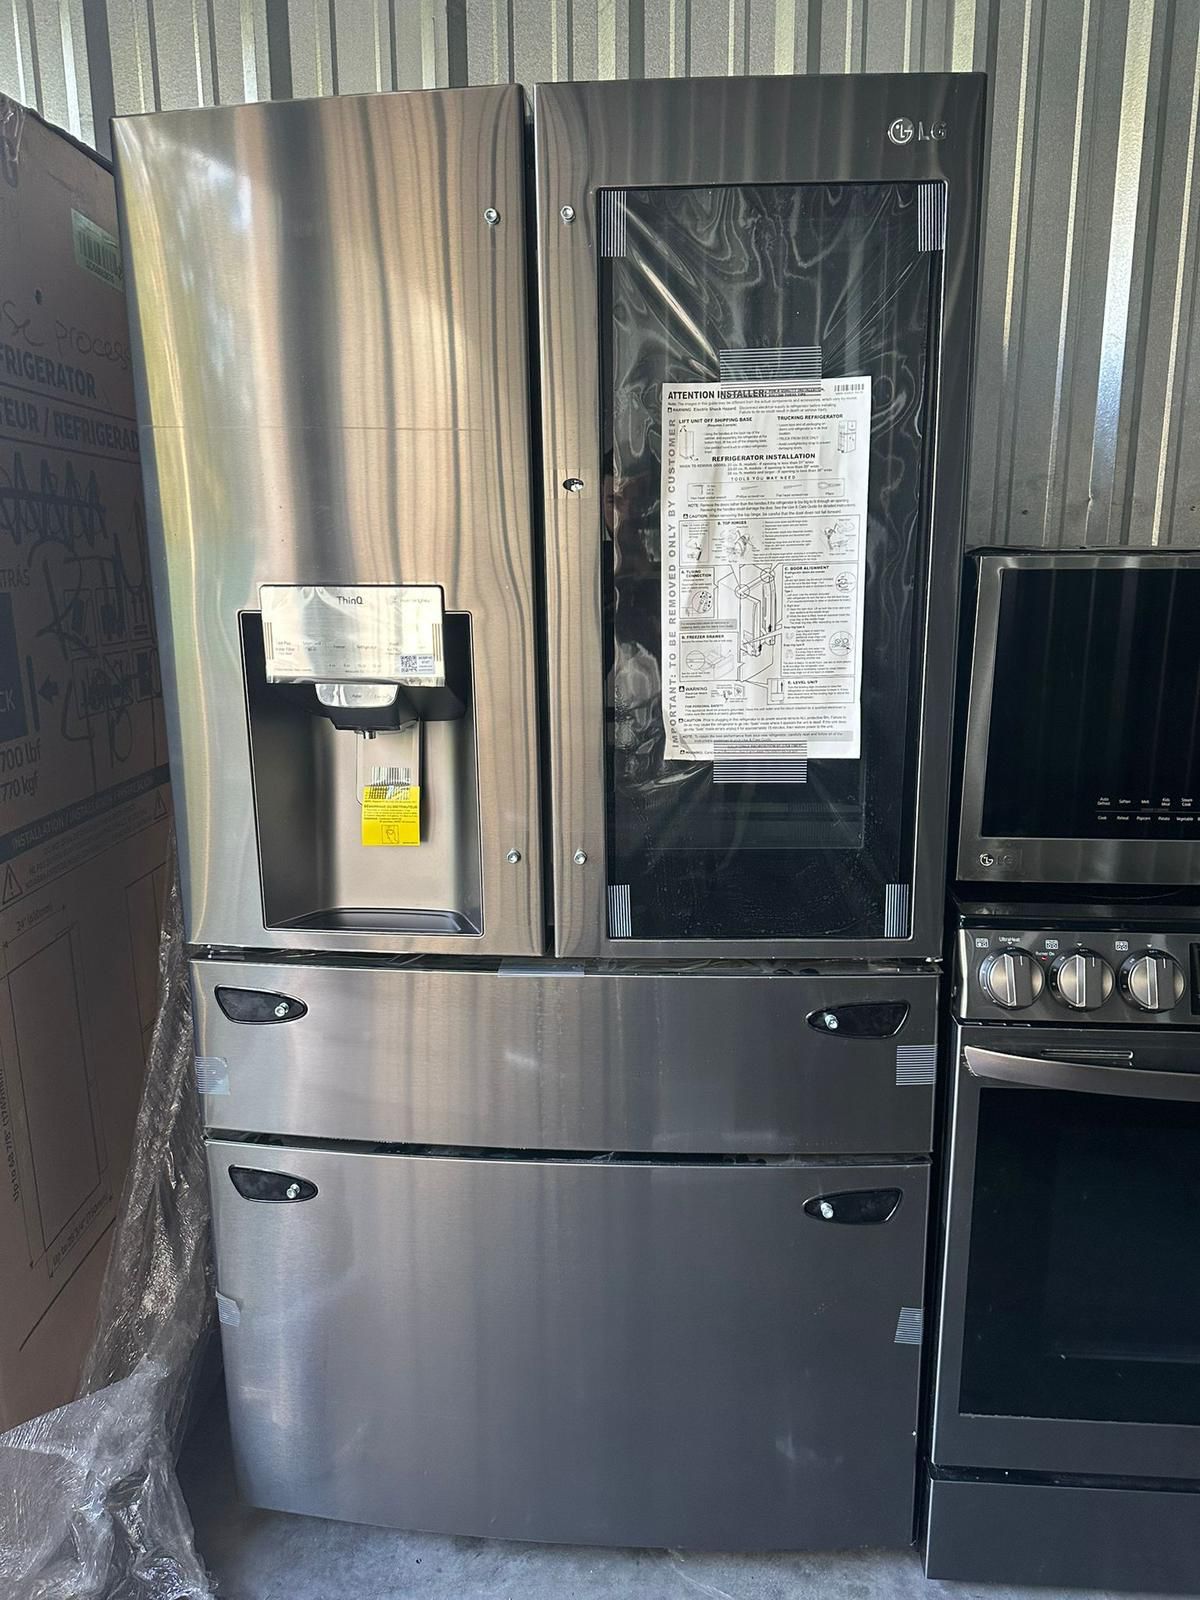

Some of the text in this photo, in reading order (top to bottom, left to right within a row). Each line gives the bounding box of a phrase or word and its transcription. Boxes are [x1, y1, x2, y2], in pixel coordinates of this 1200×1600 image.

[918, 121, 946, 141] LG
[668, 391, 715, 400] ATTENTION
[717, 390, 768, 400] INSTALLER:
[668, 419, 679, 748] IMPORTANT: TO BE REMOVED ONLY BY CUSTOMER
[336, 596, 363, 605] ThinQ
